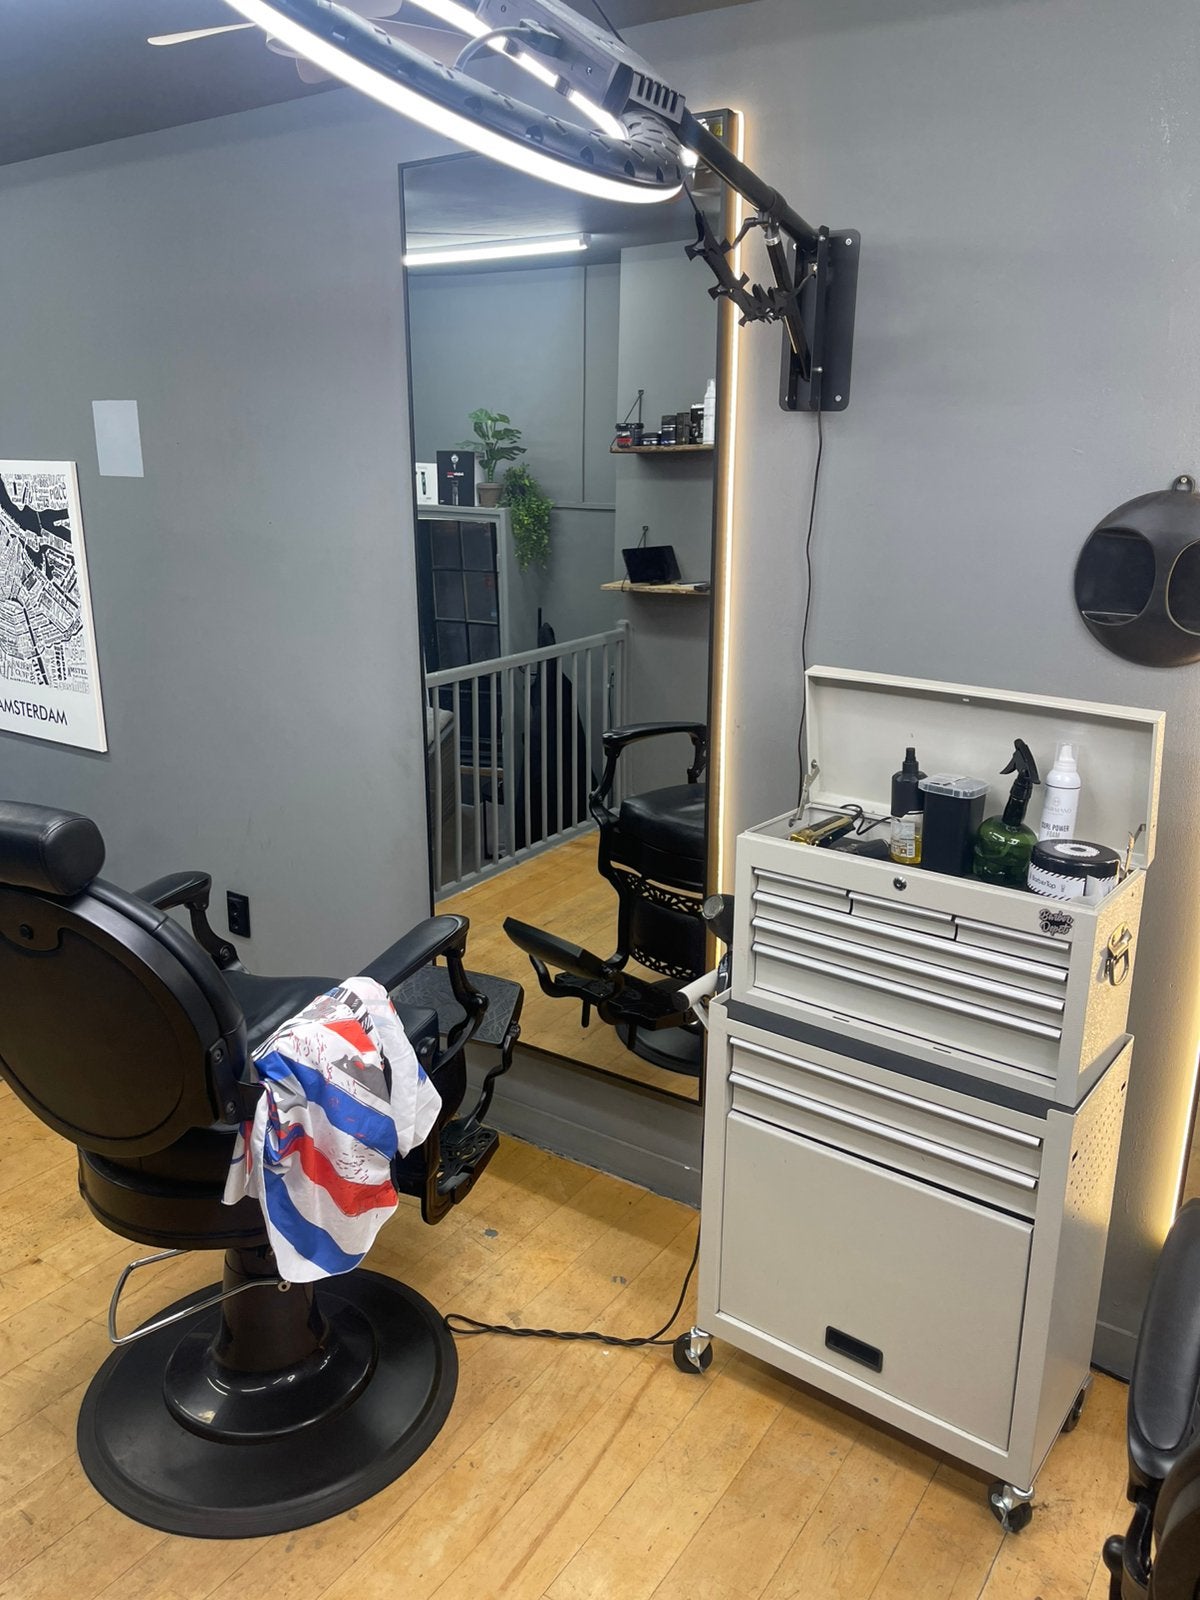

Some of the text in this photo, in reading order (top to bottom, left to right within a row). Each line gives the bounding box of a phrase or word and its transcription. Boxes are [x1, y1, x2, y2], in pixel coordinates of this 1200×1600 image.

[0, 699, 67, 725] AMSTERDAM
[1052, 824, 1070, 832] POWER
[1039, 908, 1074, 924] Barber
[1040, 920, 1073, 936] Depot
